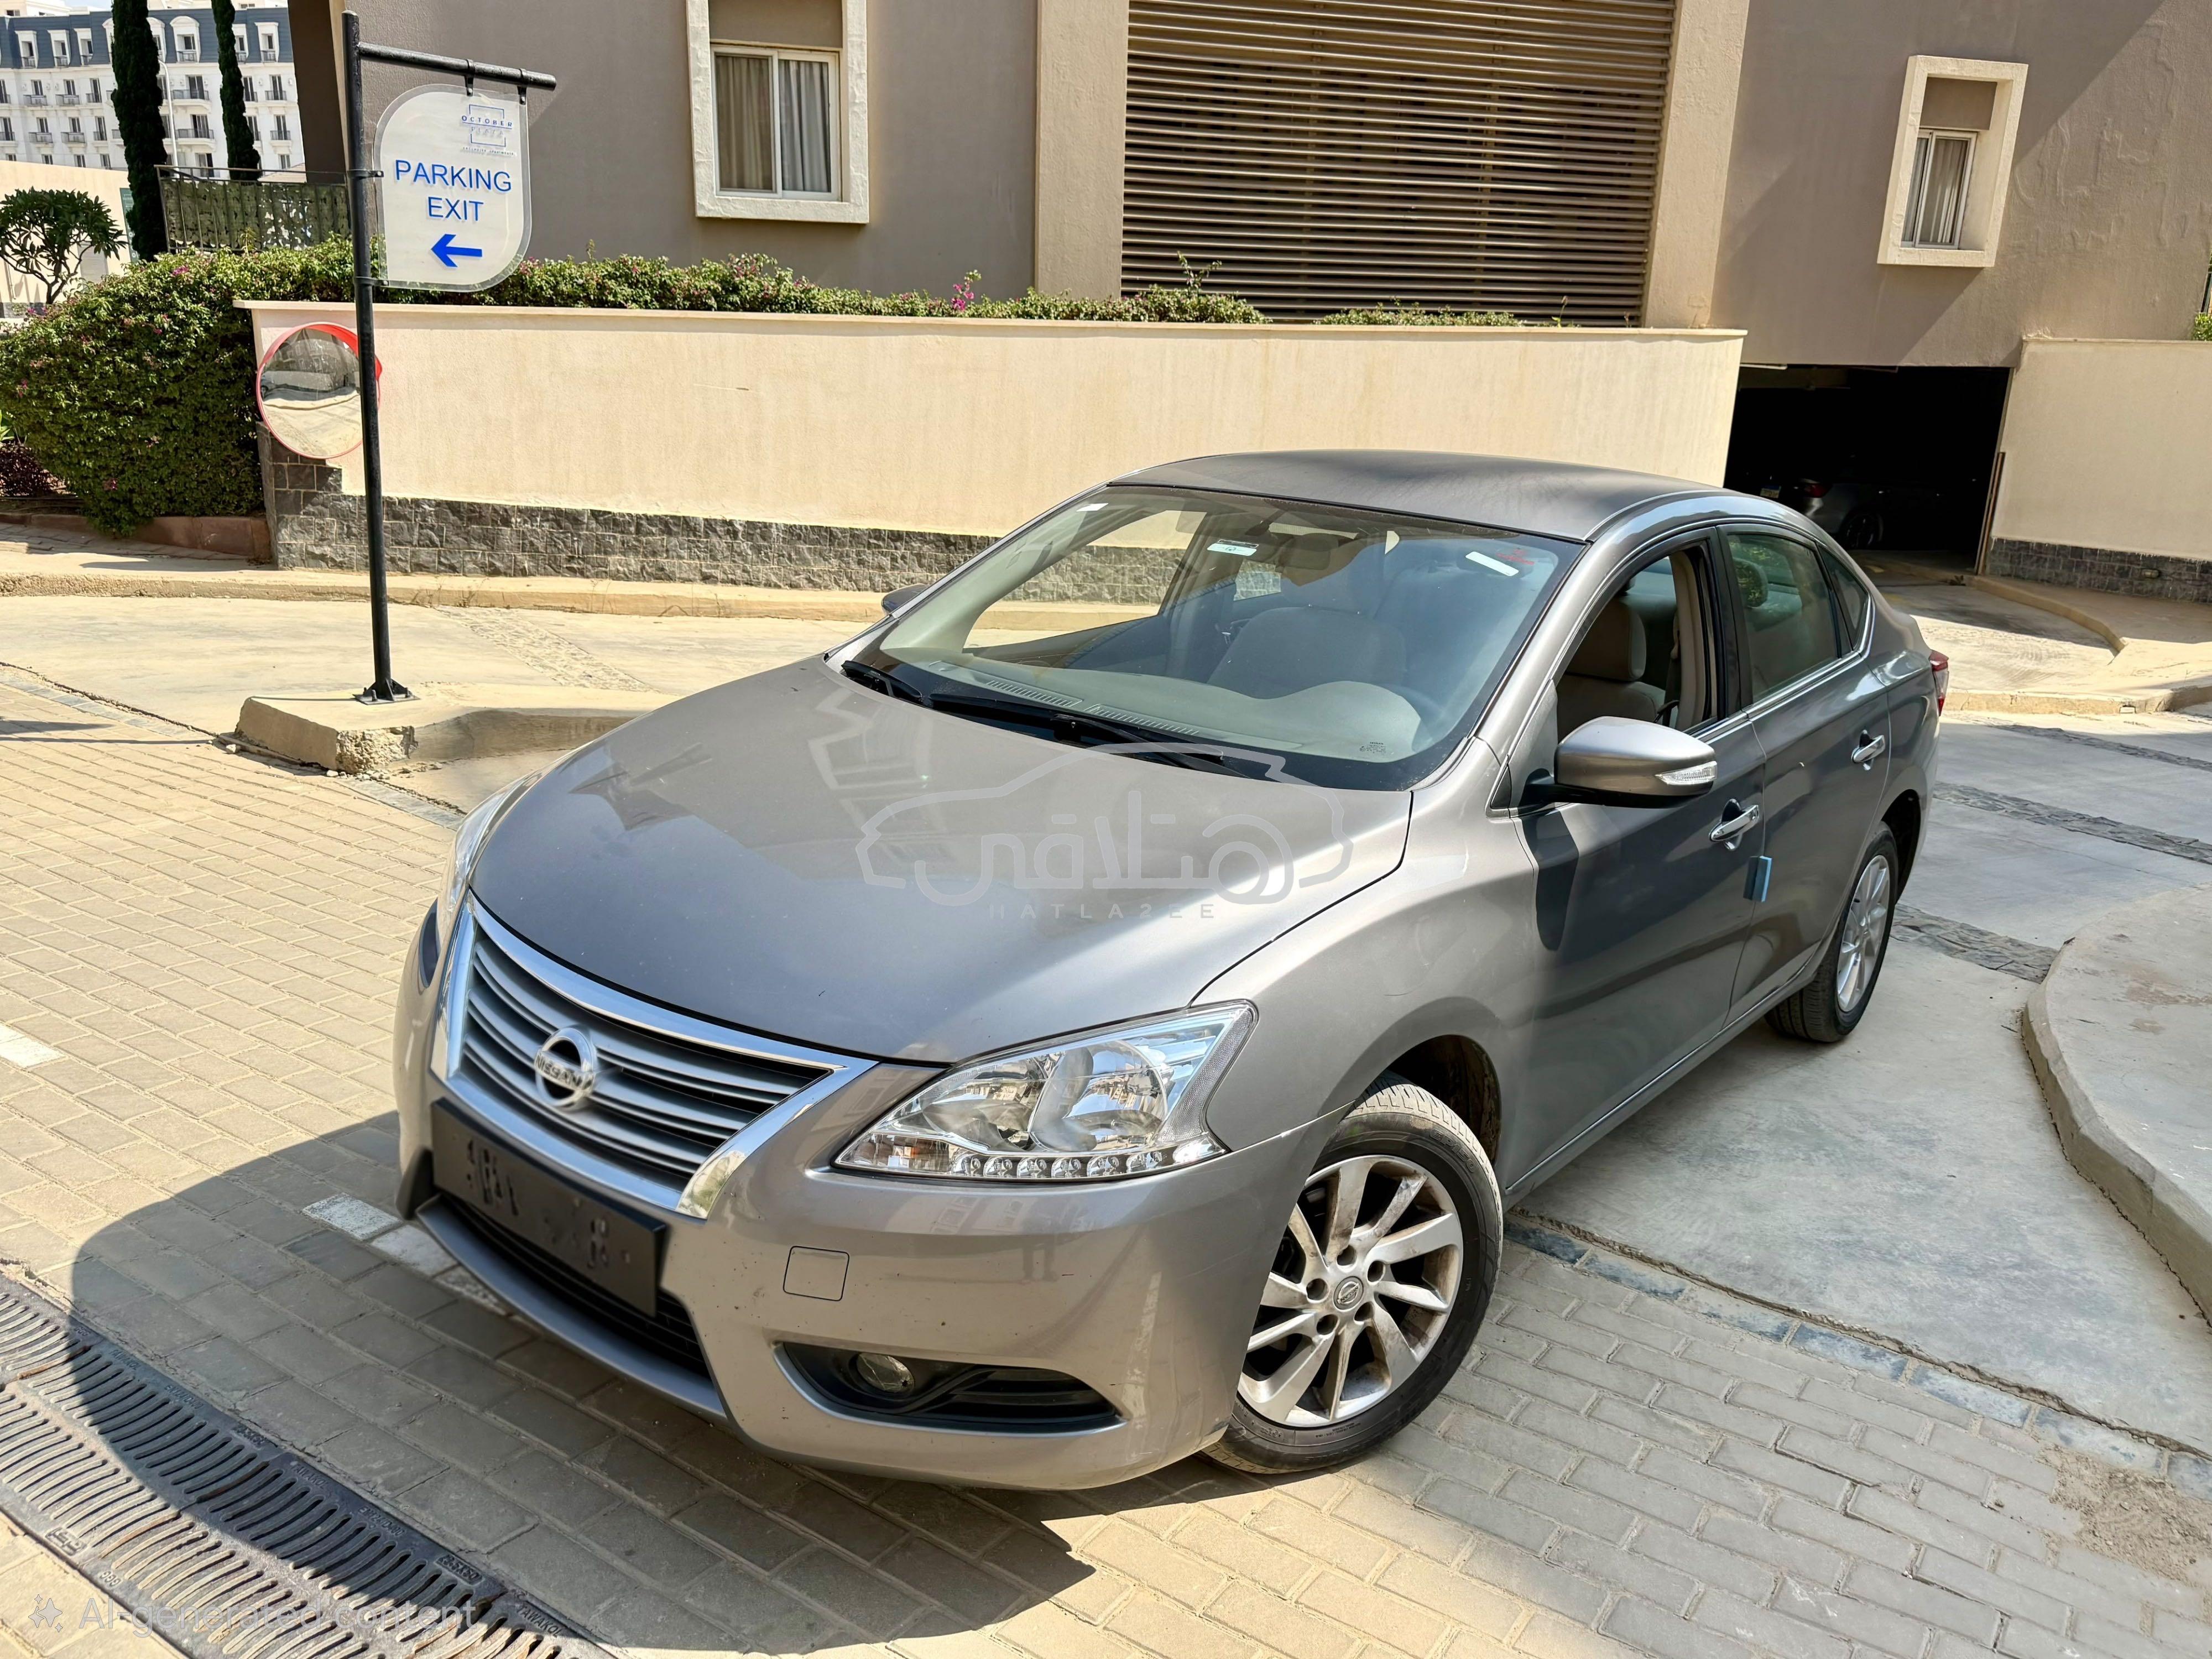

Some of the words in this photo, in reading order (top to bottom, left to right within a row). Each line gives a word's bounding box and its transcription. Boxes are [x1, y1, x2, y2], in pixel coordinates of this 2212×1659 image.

[462, 115, 512, 127] OCTOBER
[395, 159, 512, 192] PARKING
[428, 196, 484, 221] EXIT
[535, 1052, 586, 1089] NISSAN
[517, 1605, 562, 1637] TAWAKOL
